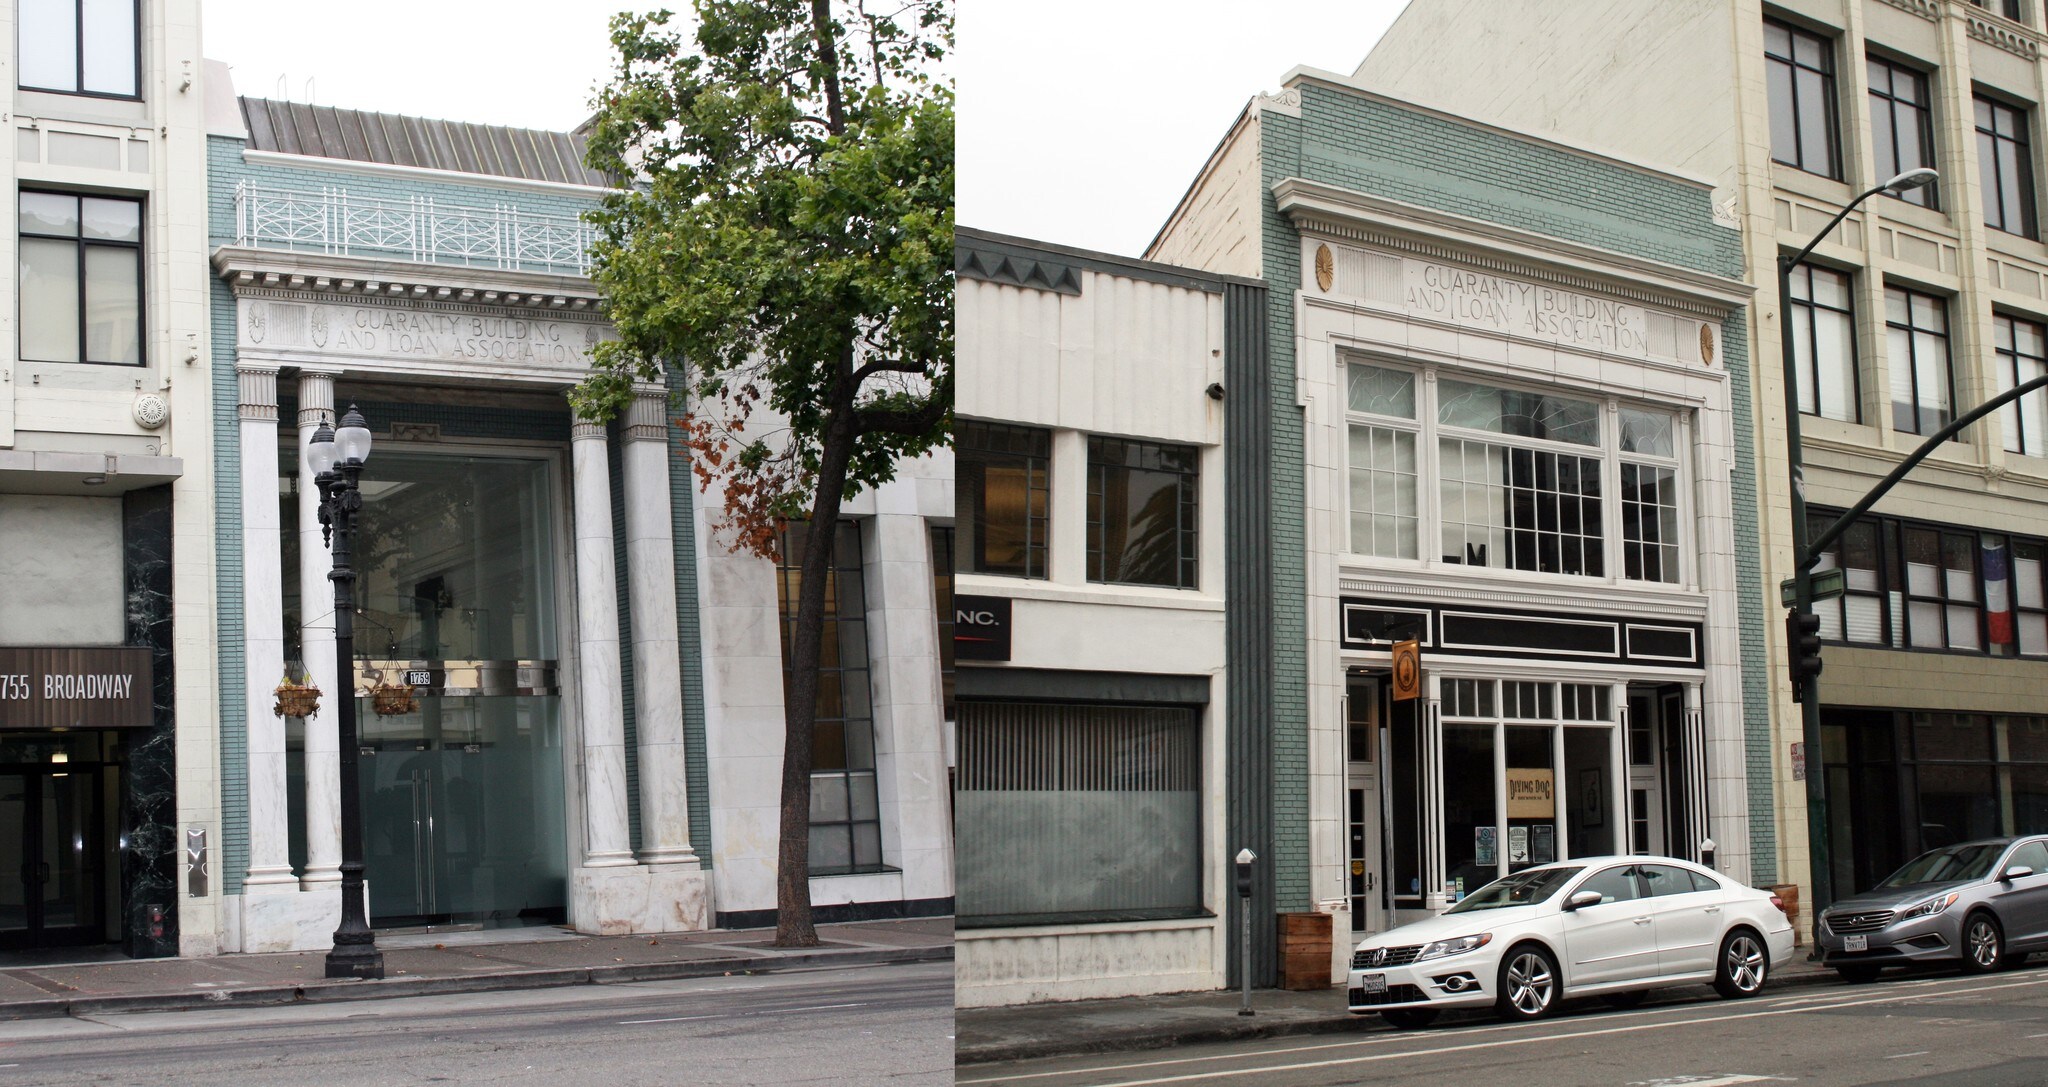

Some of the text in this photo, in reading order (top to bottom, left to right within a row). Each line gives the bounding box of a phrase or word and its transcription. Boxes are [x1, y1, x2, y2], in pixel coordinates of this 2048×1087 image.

[1424, 266, 1628, 325] GUARANTY BUILDING
[355, 310, 560, 342] GUARANTY BUILDING
[1406, 286, 1645, 350] AND LOAN ASSOCIATION
[337, 331, 580, 363] AND LOAN ASSOCIATION
[0, 674, 132, 699] 755 BROADWAY
[411, 672, 430, 684] 1759
[1510, 779, 1550, 800] DIVING DOG
